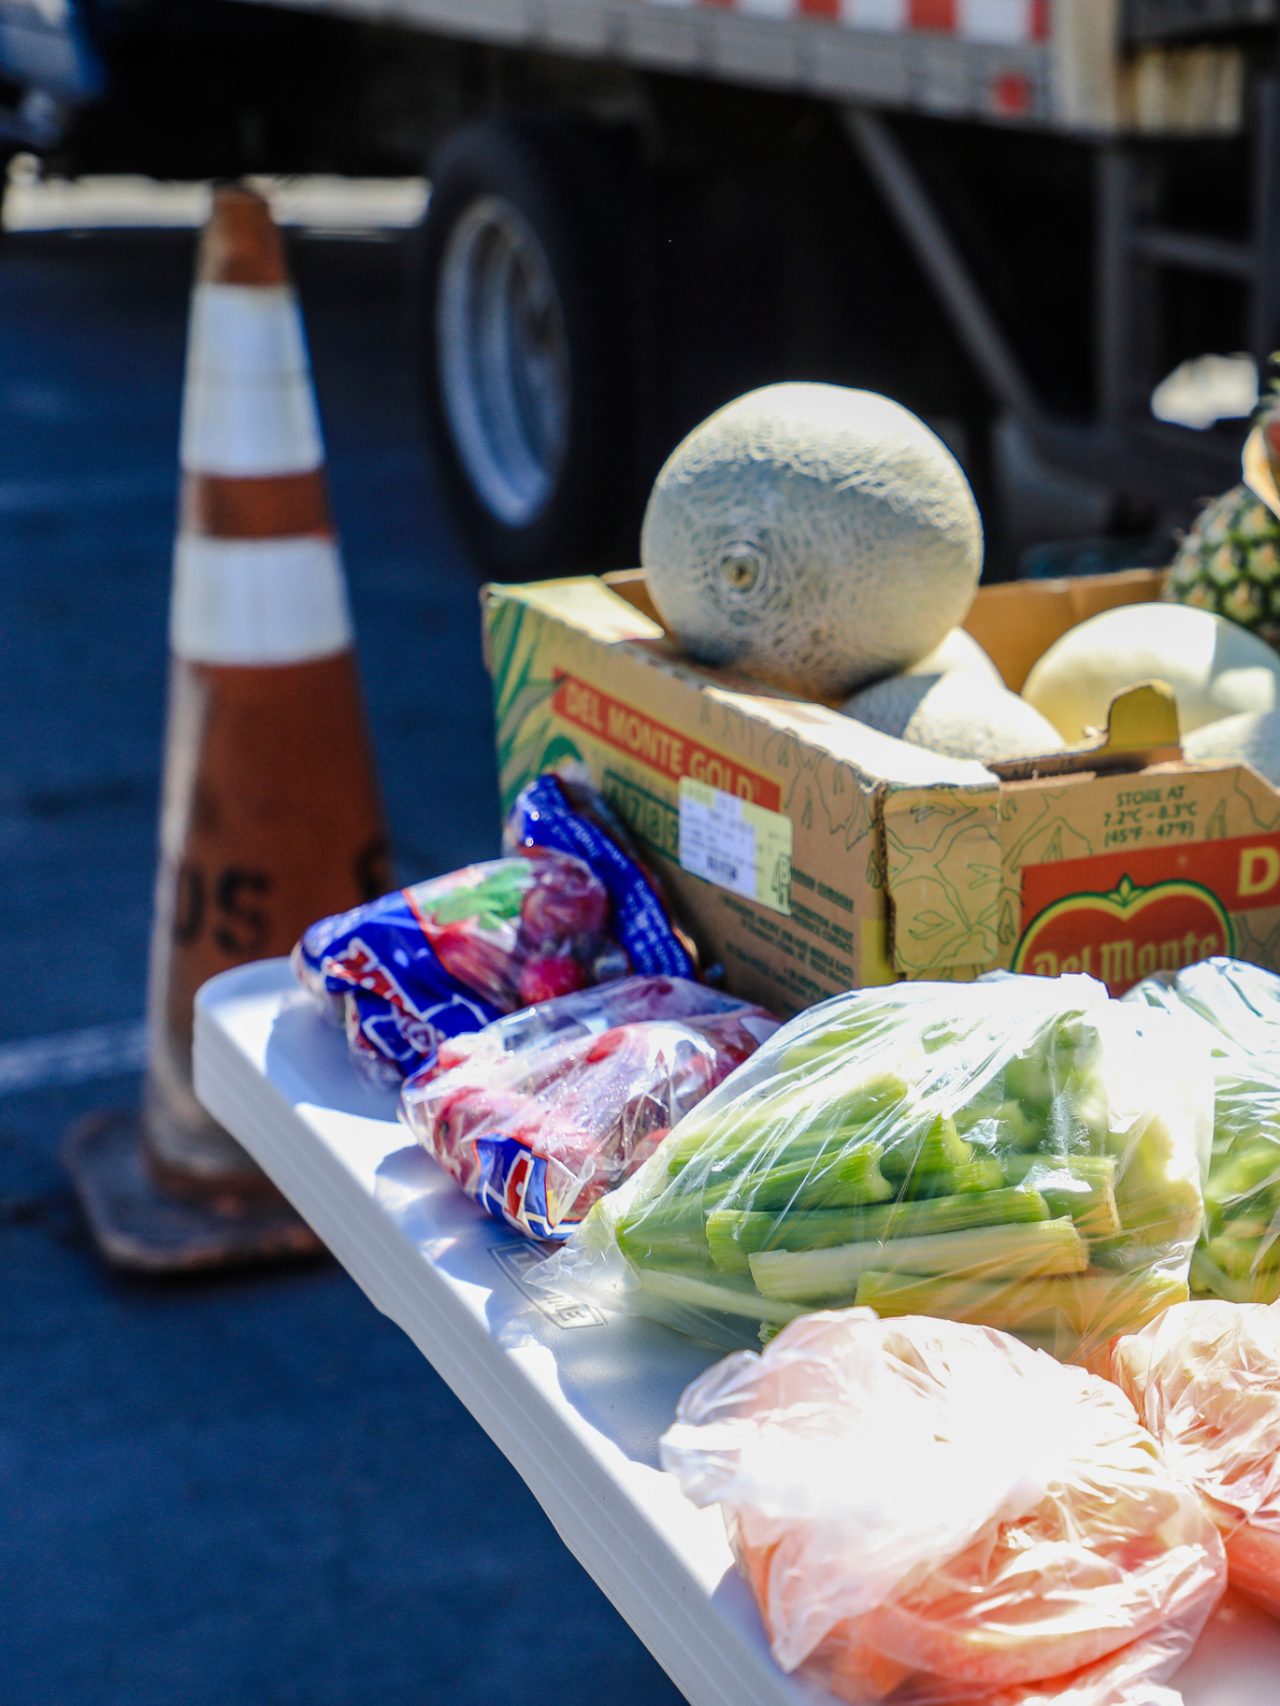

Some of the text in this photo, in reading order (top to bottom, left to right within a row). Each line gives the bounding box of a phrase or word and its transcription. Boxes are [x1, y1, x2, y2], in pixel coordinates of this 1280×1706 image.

[565, 679, 754, 800] DEL MONTE GOLD
[1116, 784, 1186, 808] STORE AT
[1100, 930, 1220, 984] Monte
